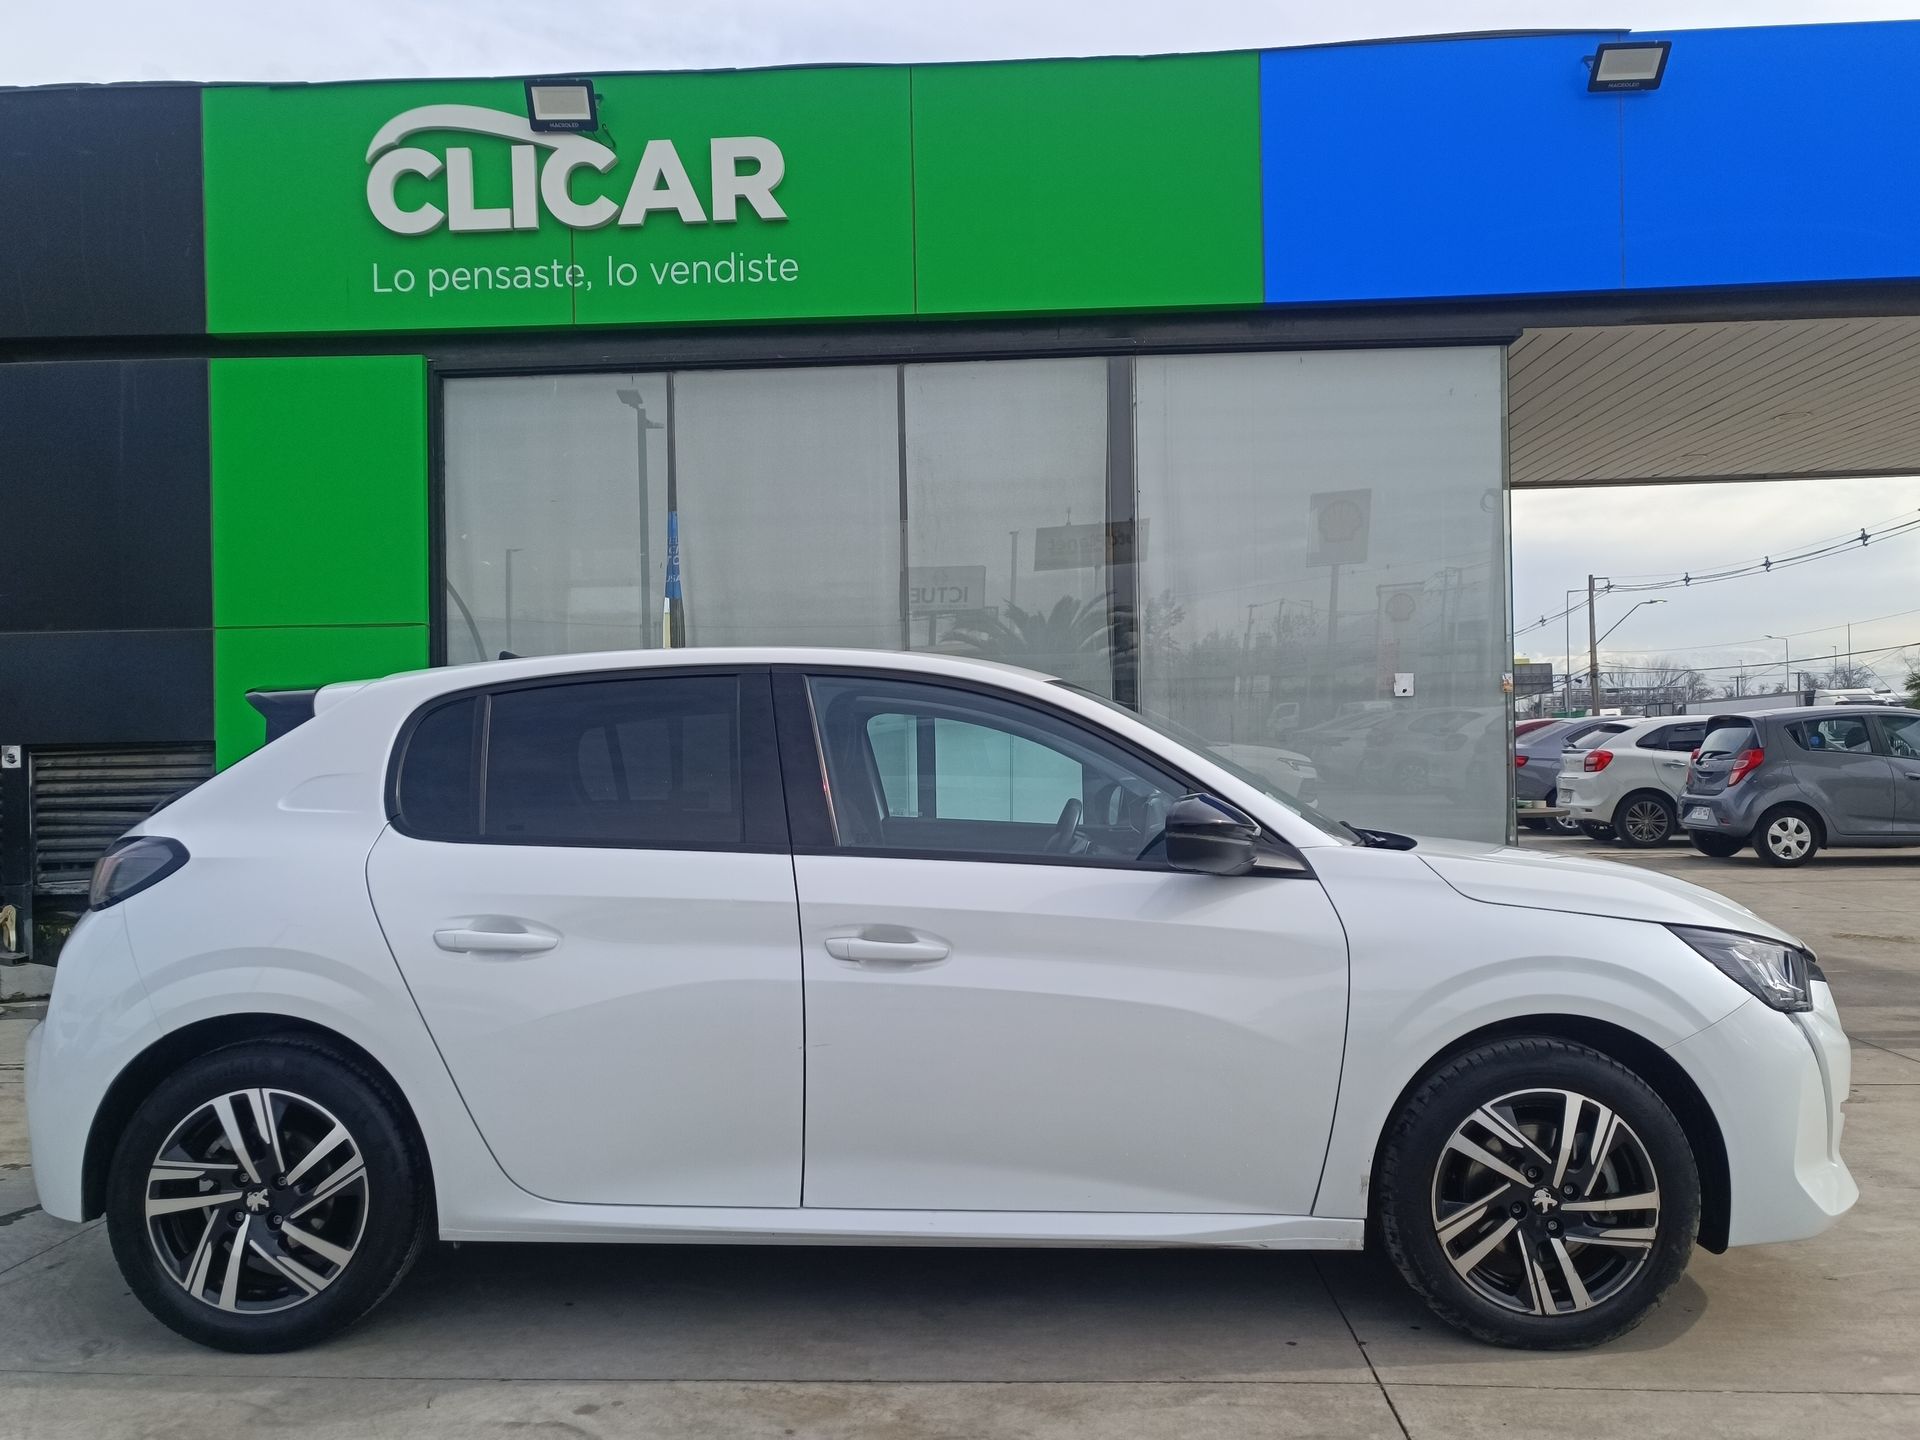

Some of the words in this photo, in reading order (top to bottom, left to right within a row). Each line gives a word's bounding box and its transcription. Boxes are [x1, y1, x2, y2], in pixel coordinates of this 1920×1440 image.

[366, 130, 789, 236] CLICAR
[372, 262, 416, 294] Lo
[428, 257, 593, 298] pensaste,
[607, 254, 638, 287] lo
[650, 251, 800, 286] vendiste
